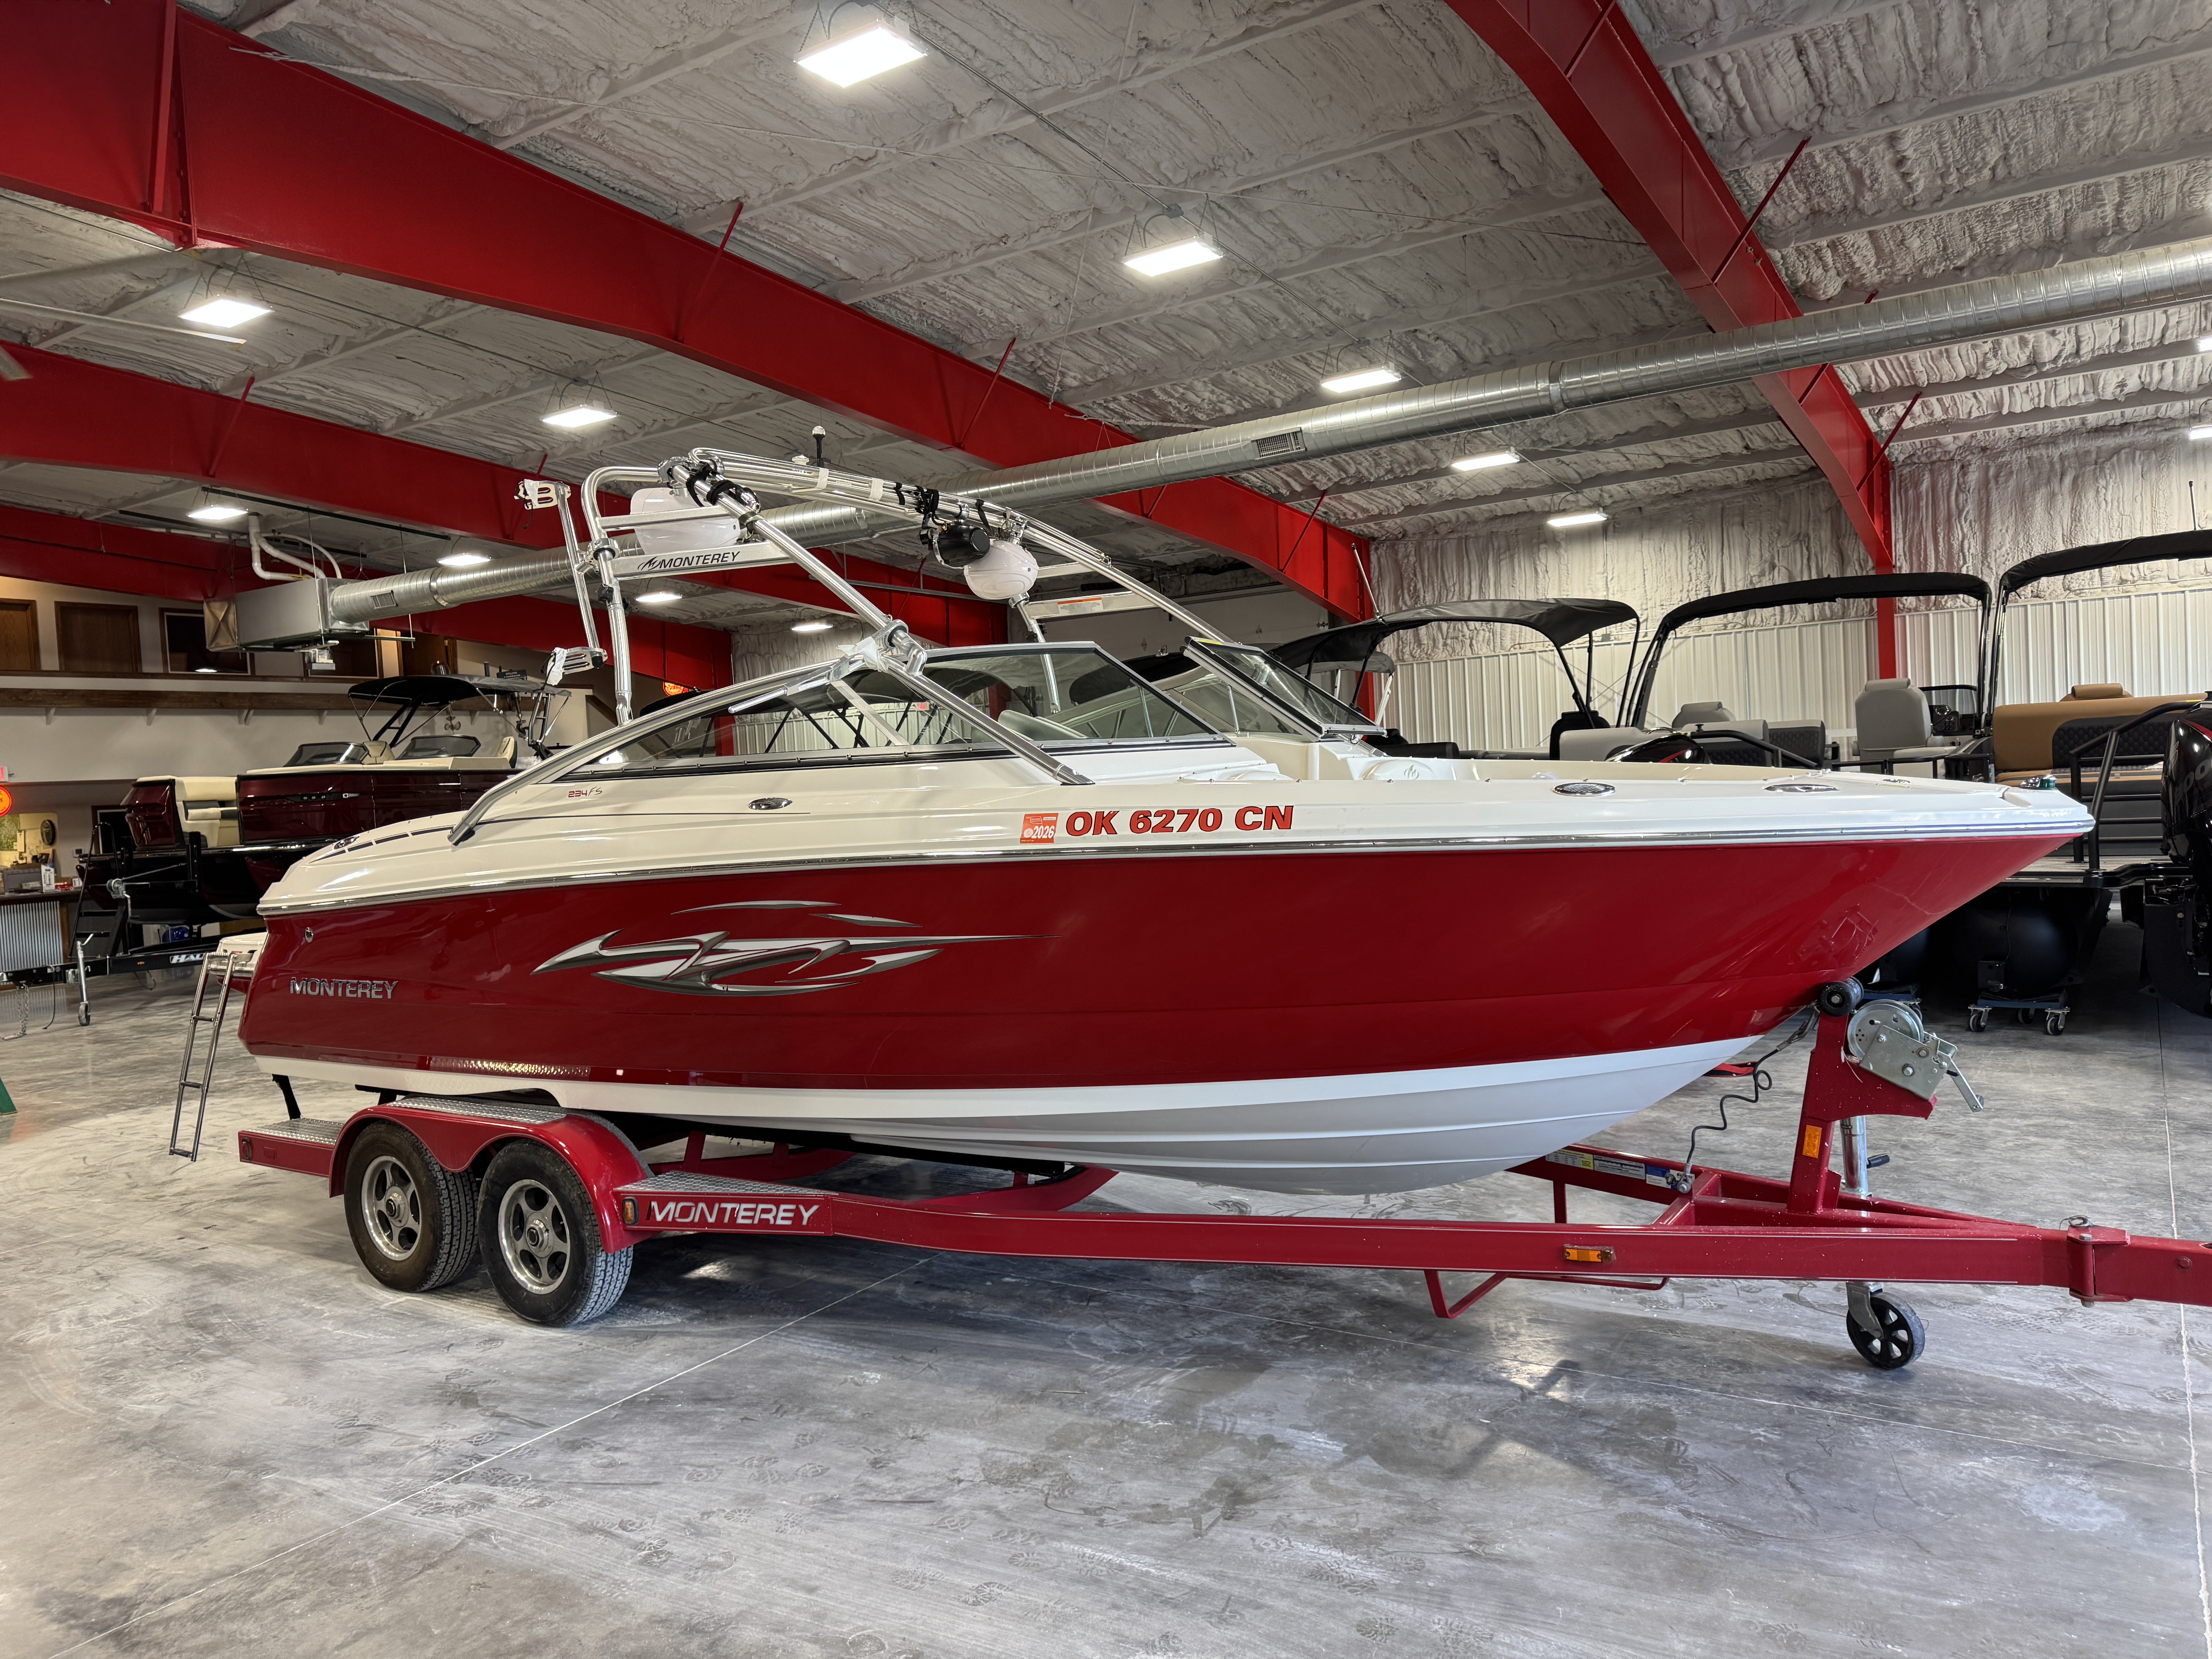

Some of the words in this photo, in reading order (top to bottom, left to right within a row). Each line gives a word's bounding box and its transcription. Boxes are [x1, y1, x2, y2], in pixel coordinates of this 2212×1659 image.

[659, 551, 740, 569] MONTEREY
[1066, 811, 1120, 836] OK
[1129, 808, 1223, 834] 6270
[1235, 805, 1294, 831] CN
[1031, 825, 1055, 839] 2026
[290, 977, 398, 999] MONTEREY
[646, 1201, 820, 1226] MONTEREY
